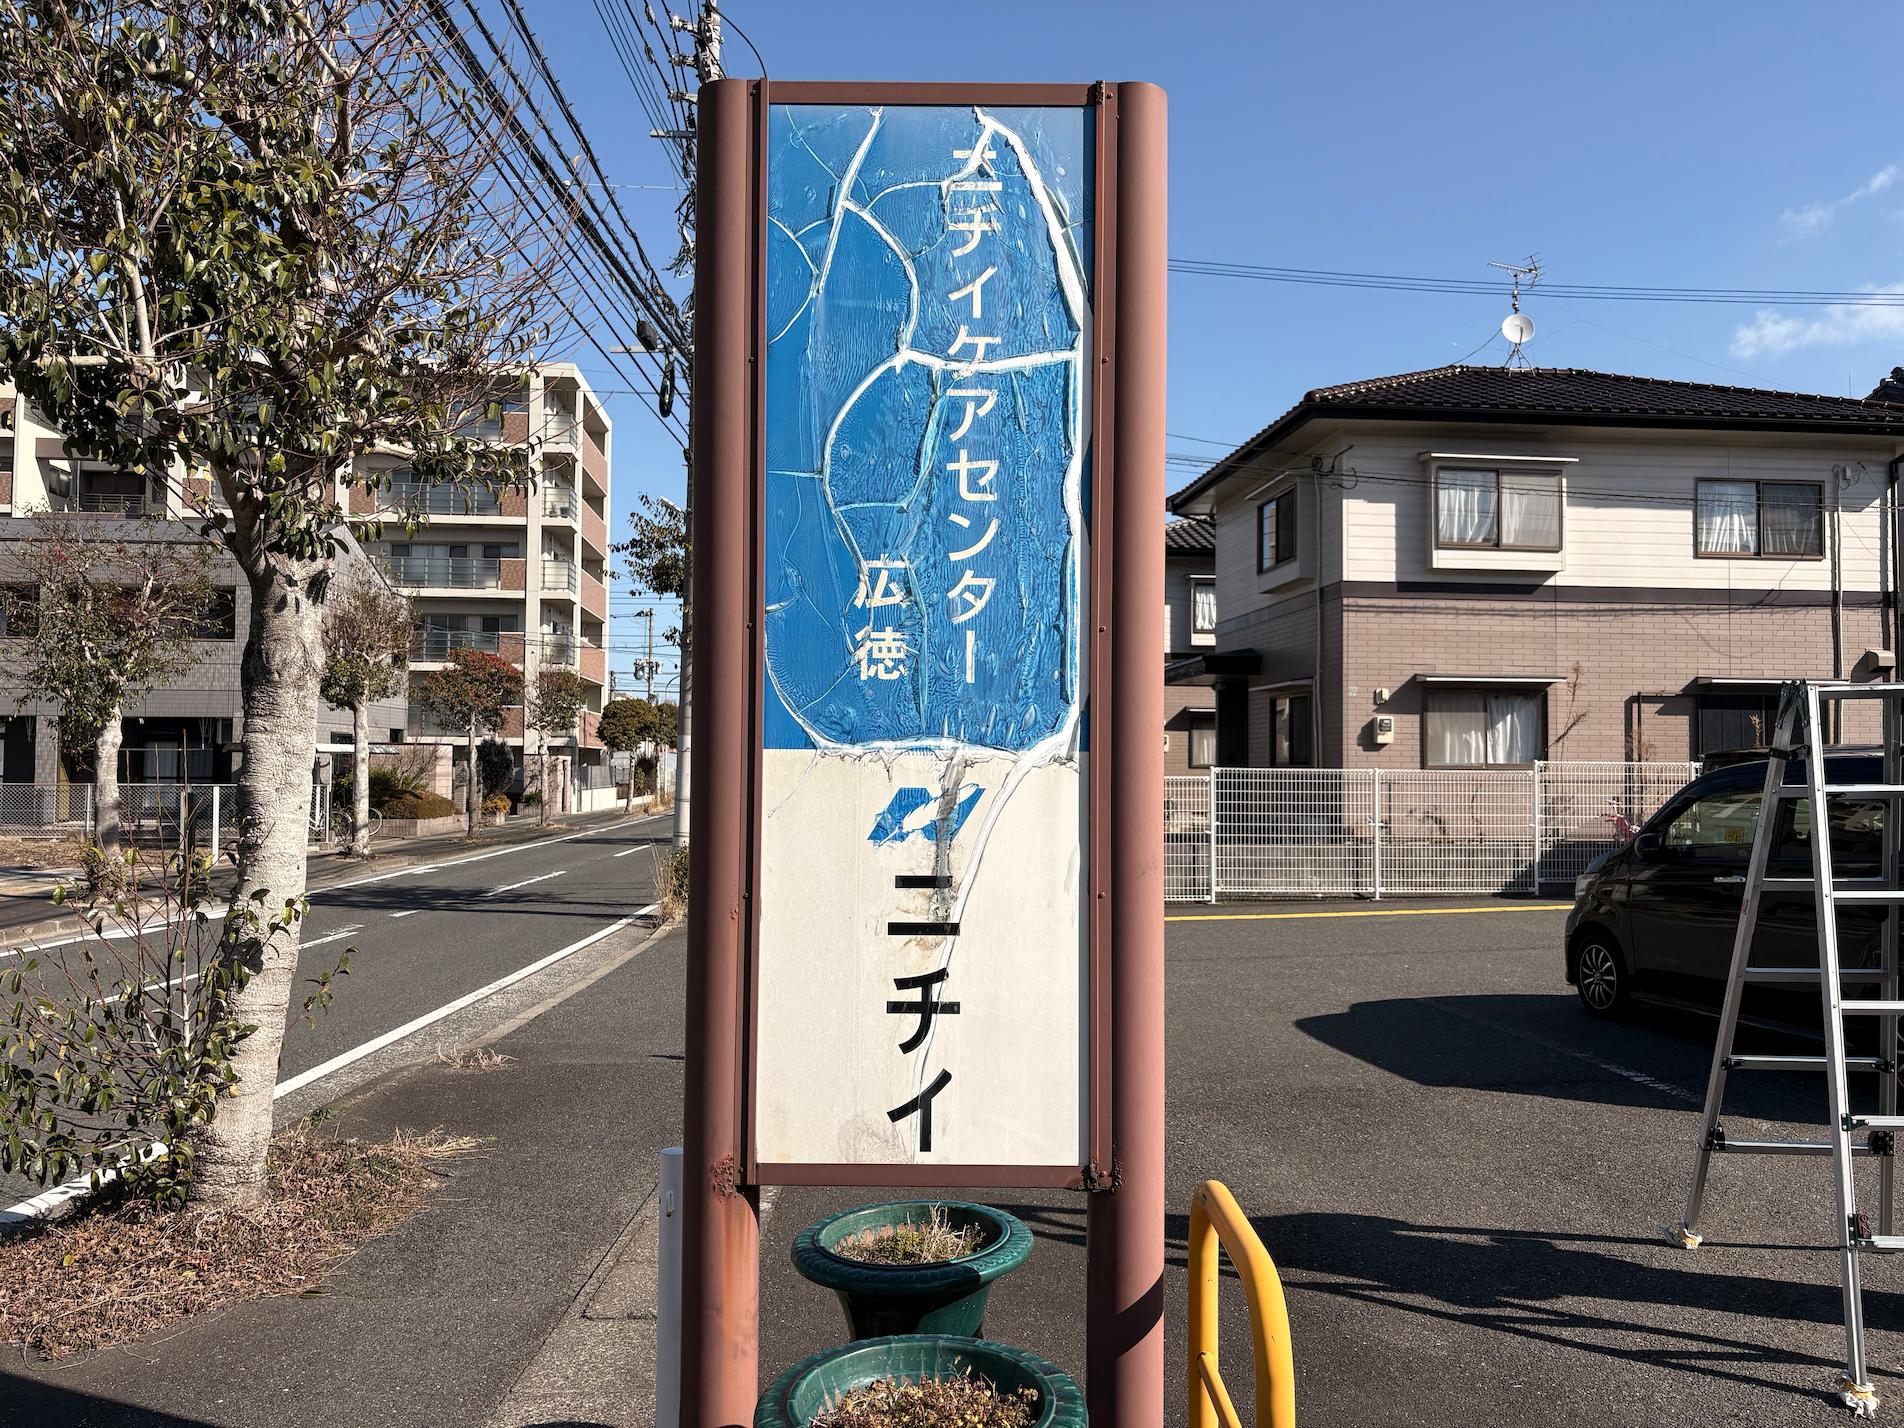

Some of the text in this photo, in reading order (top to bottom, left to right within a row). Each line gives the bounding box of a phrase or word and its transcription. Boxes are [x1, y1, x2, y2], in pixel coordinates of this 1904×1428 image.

[946, 149, 1003, 685] ニチイケアセンター
[854, 555, 909, 682] 広徳
[886, 875, 961, 1153] ニチイ
